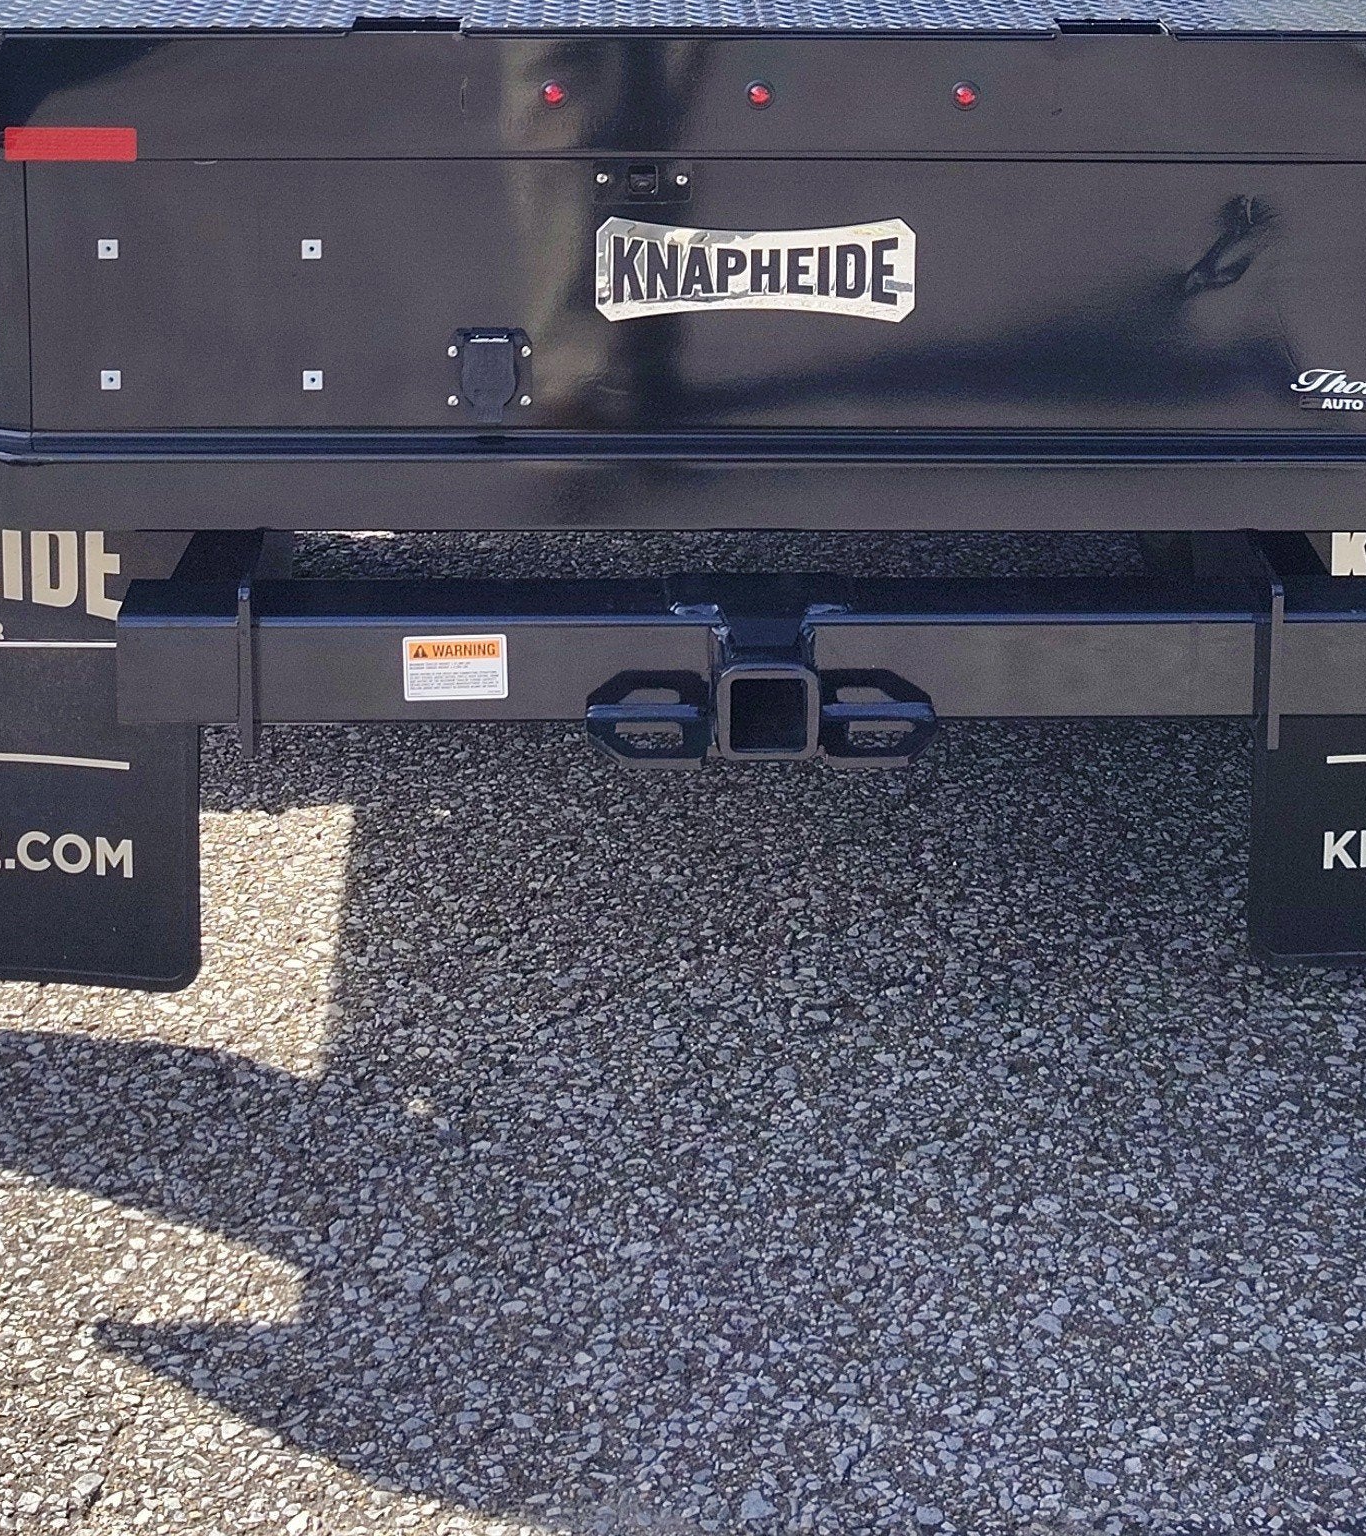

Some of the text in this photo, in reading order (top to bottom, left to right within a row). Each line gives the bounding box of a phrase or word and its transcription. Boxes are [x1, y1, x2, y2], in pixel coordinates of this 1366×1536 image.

[612, 236, 899, 306] KNAPHEIDE
[1321, 398, 1364, 411] AUTO
[432, 643, 496, 657] WARNING
